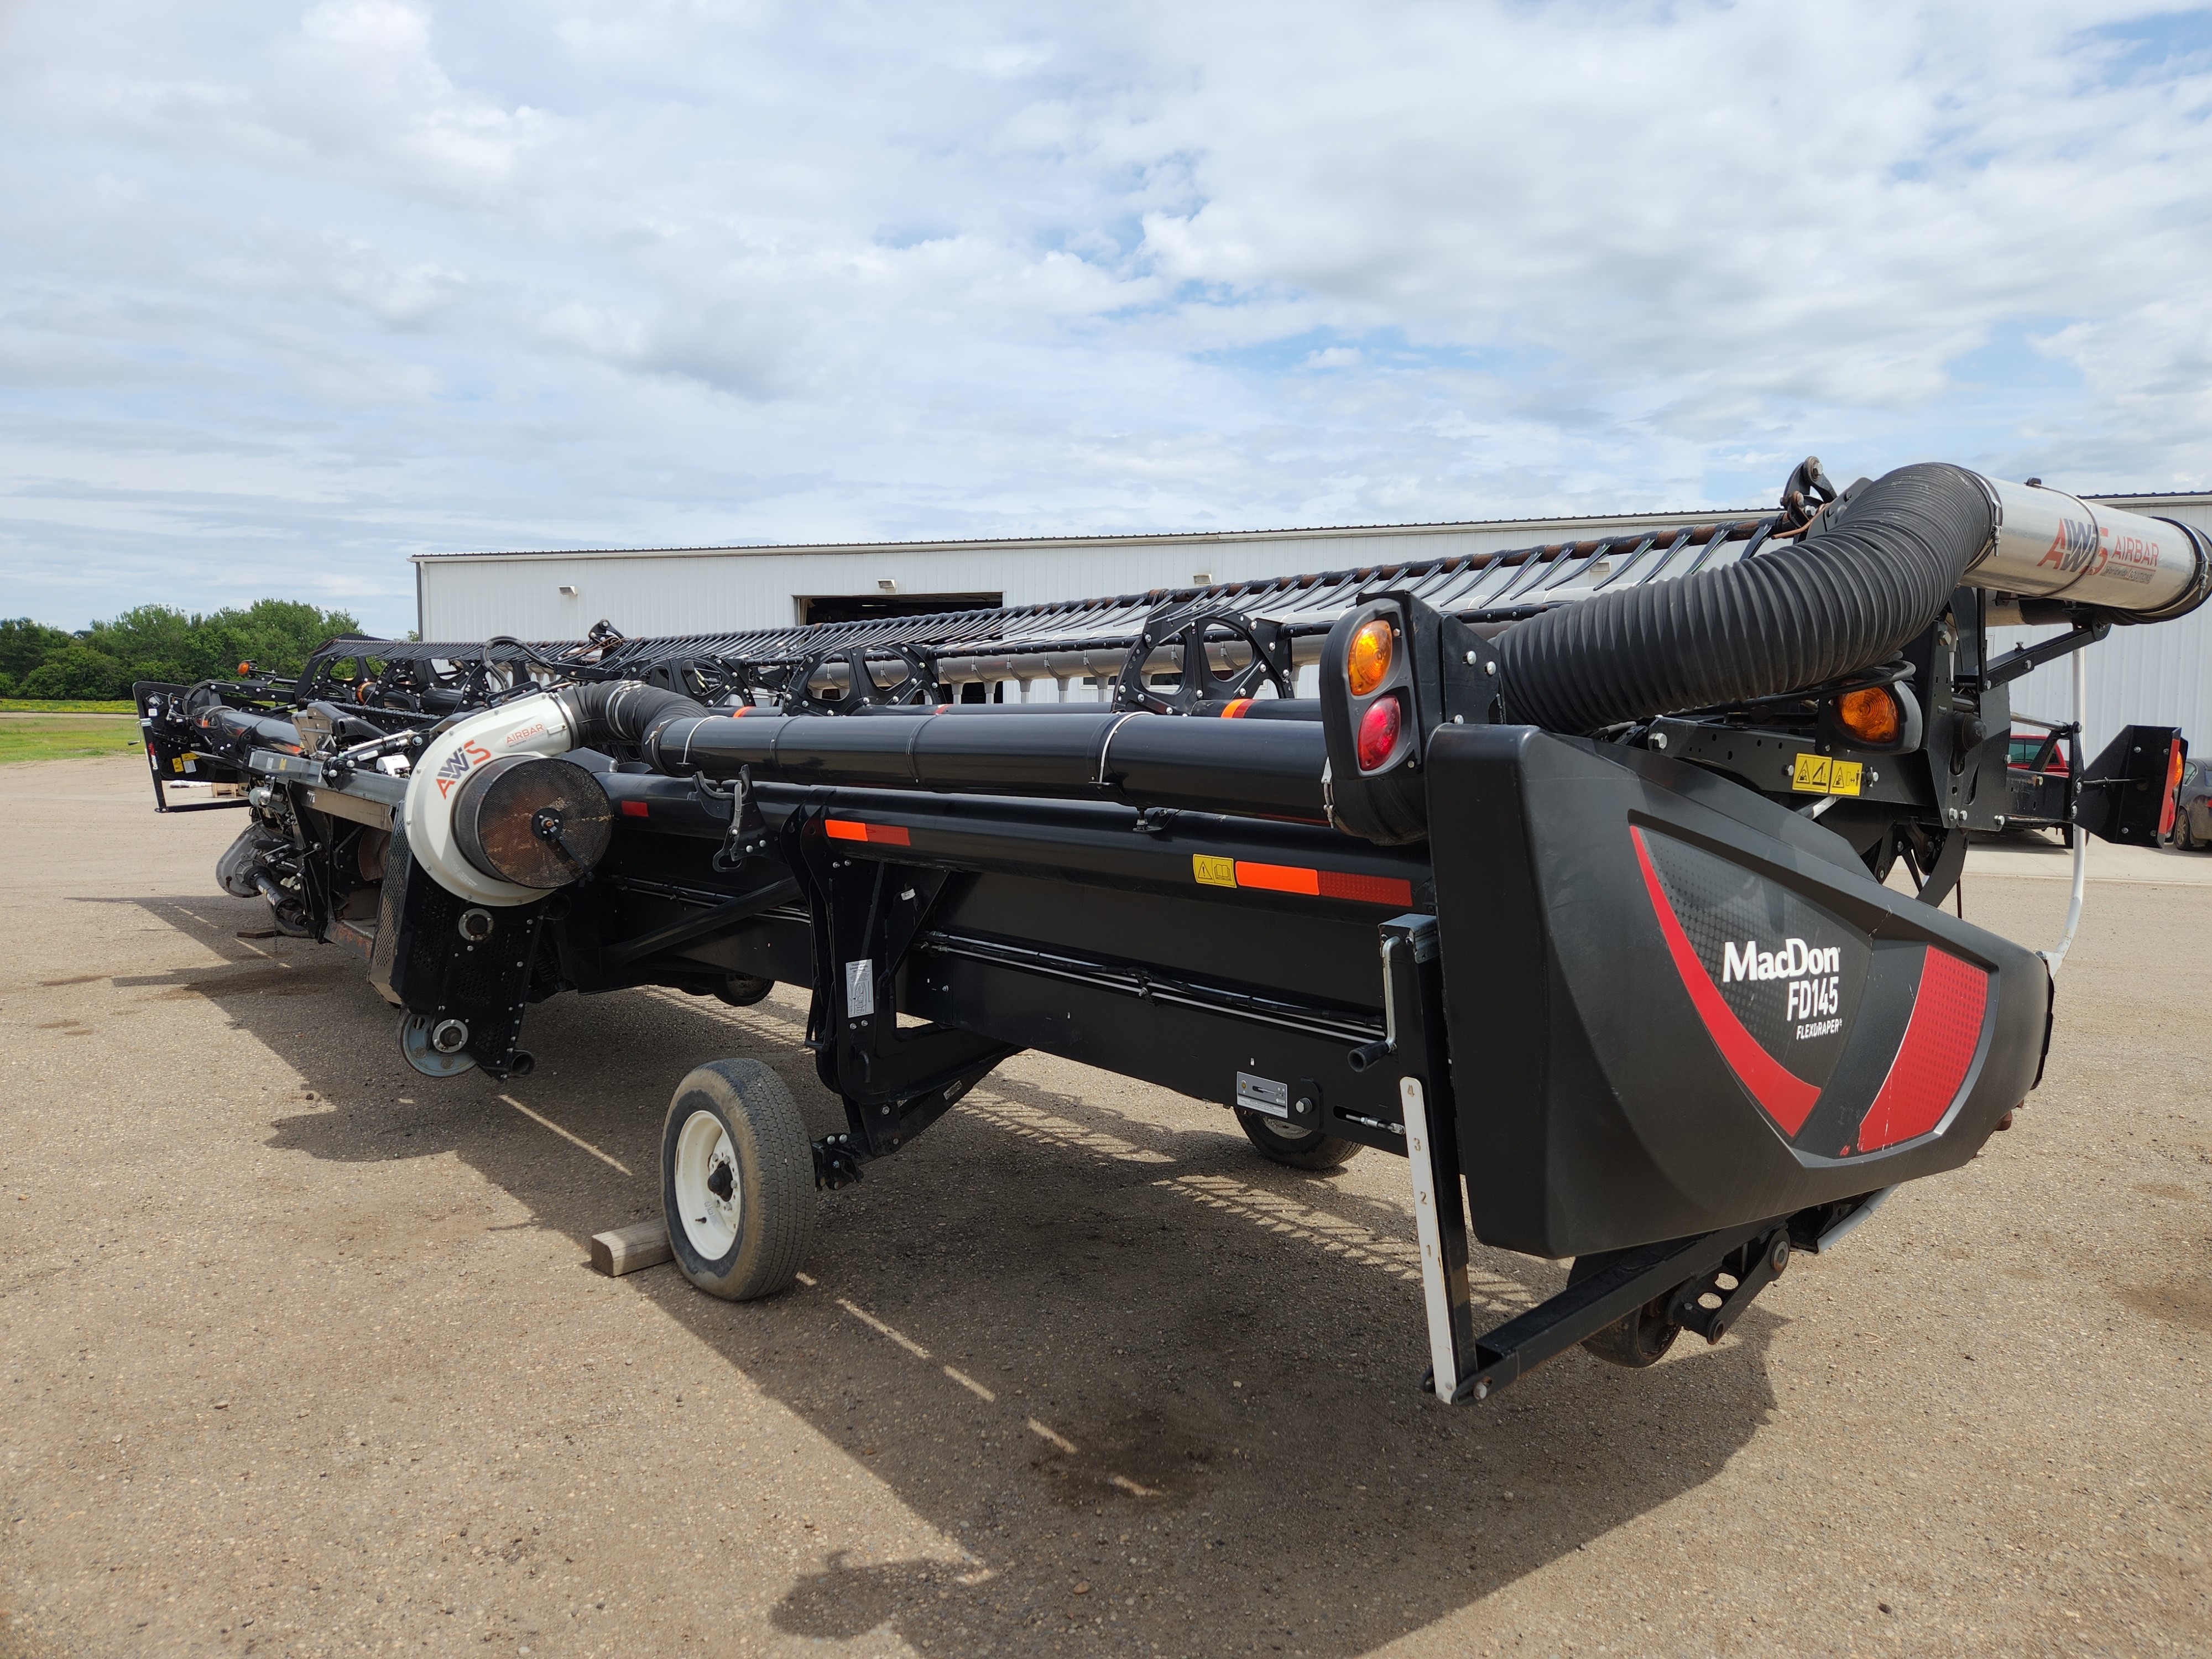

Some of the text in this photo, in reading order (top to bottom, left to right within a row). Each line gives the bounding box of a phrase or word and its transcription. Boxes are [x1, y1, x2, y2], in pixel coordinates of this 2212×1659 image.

[2036, 518, 2159, 575] AWS AIRBAR
[506, 723, 544, 744] AIRBAR
[435, 739, 491, 800] AWS
[1723, 938, 1840, 983] MacDon
[1786, 976, 1839, 1022] FD145
[1796, 1019, 1840, 1041] FLEXDRAPER
[1407, 1084, 1415, 1098] 4
[1413, 1138, 1421, 1151] 3
[1420, 1191, 1428, 1205] 2
[1426, 1244, 1432, 1258] 1
